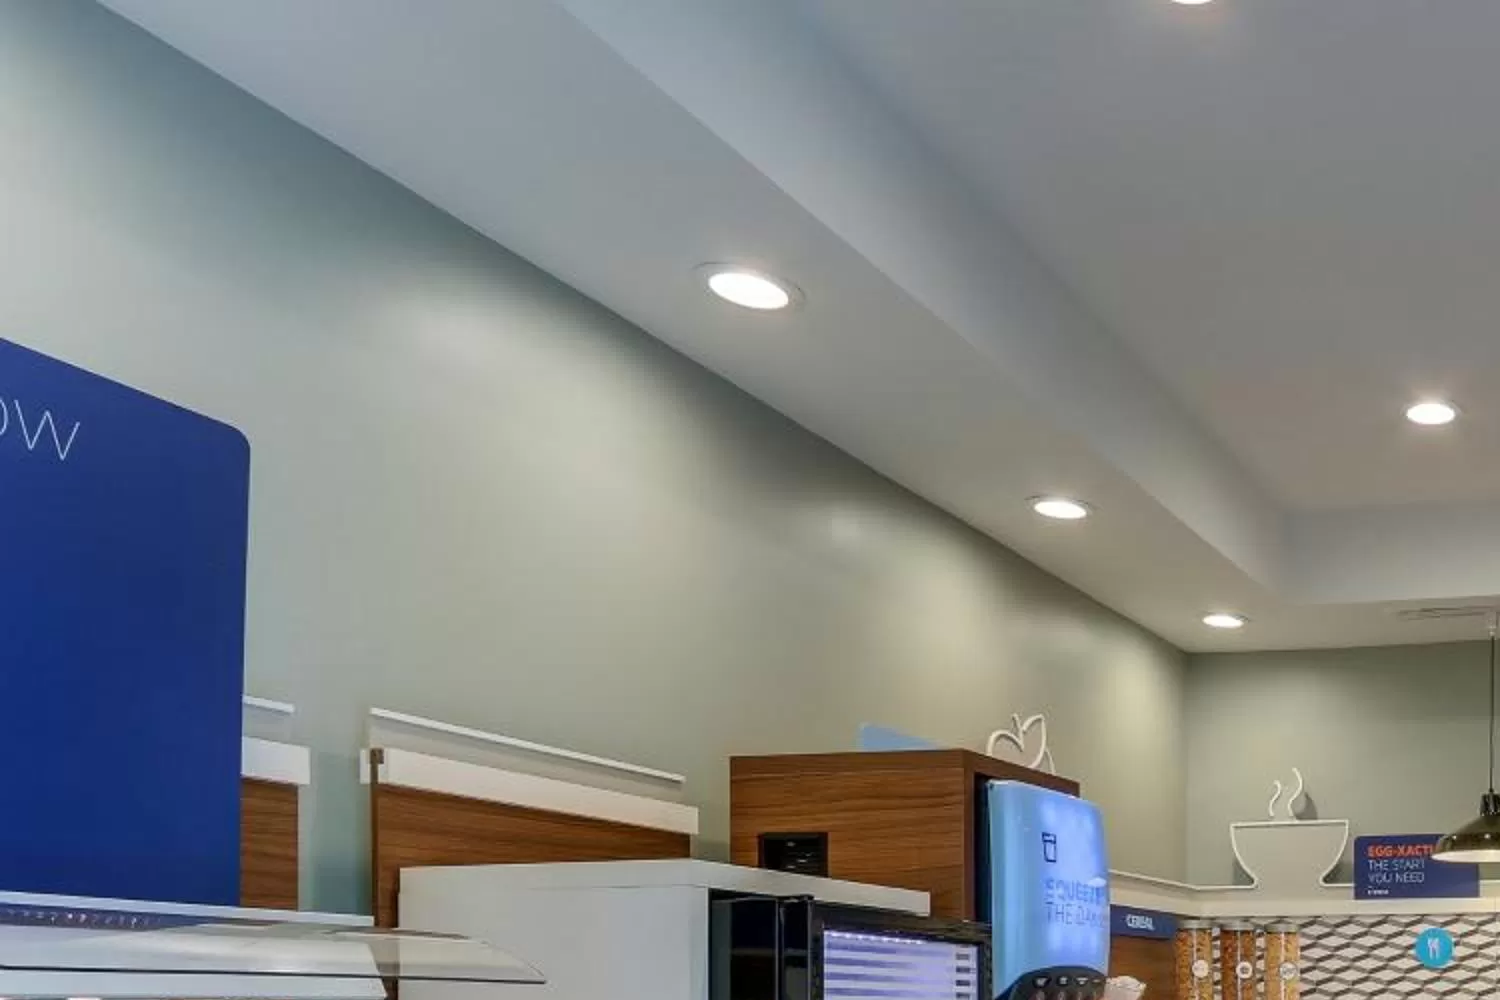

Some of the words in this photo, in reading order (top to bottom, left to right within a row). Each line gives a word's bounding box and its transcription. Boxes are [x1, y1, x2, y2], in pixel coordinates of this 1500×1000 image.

[1368, 860, 1389, 871] THE
[1392, 859, 1425, 871] START
[1368, 872, 1392, 884] YOU
[1396, 872, 1425, 883] NEED
